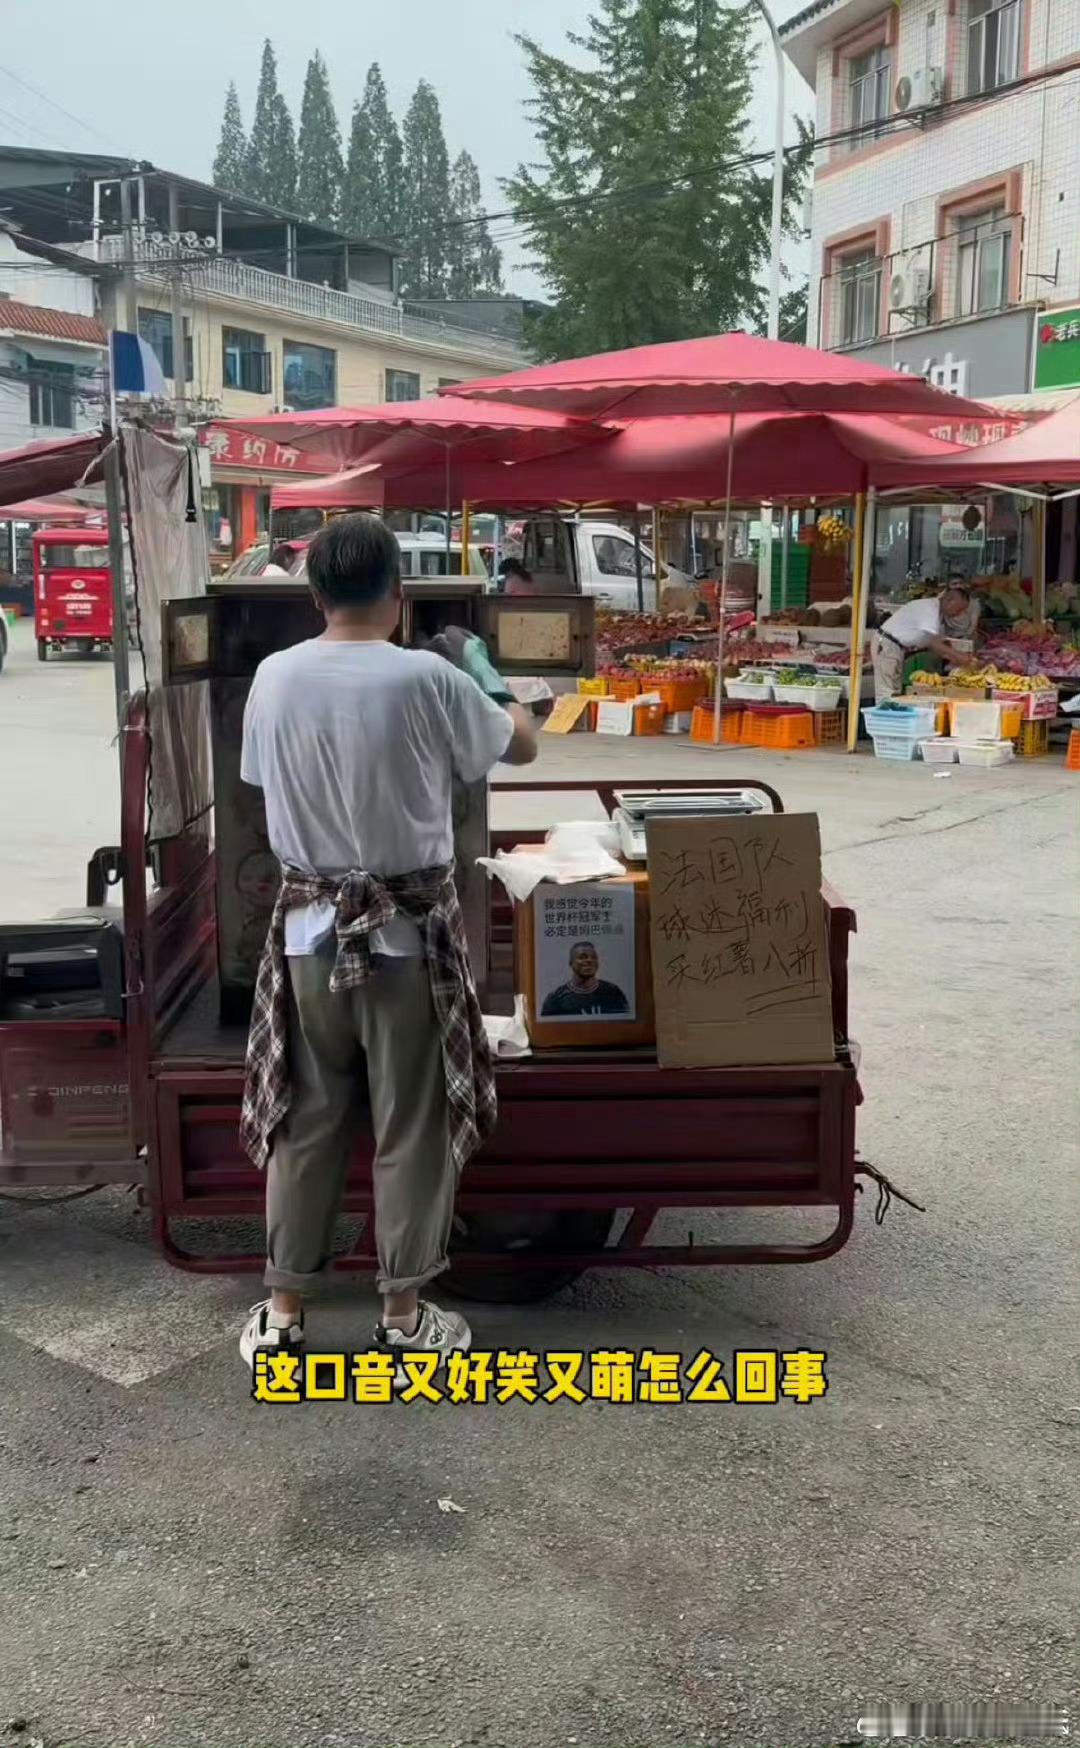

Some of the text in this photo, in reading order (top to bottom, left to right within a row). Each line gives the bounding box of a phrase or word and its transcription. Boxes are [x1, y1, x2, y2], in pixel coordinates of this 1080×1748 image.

[661, 837, 795, 895] 法国队
[544, 896, 614, 911] 我感觉今年的
